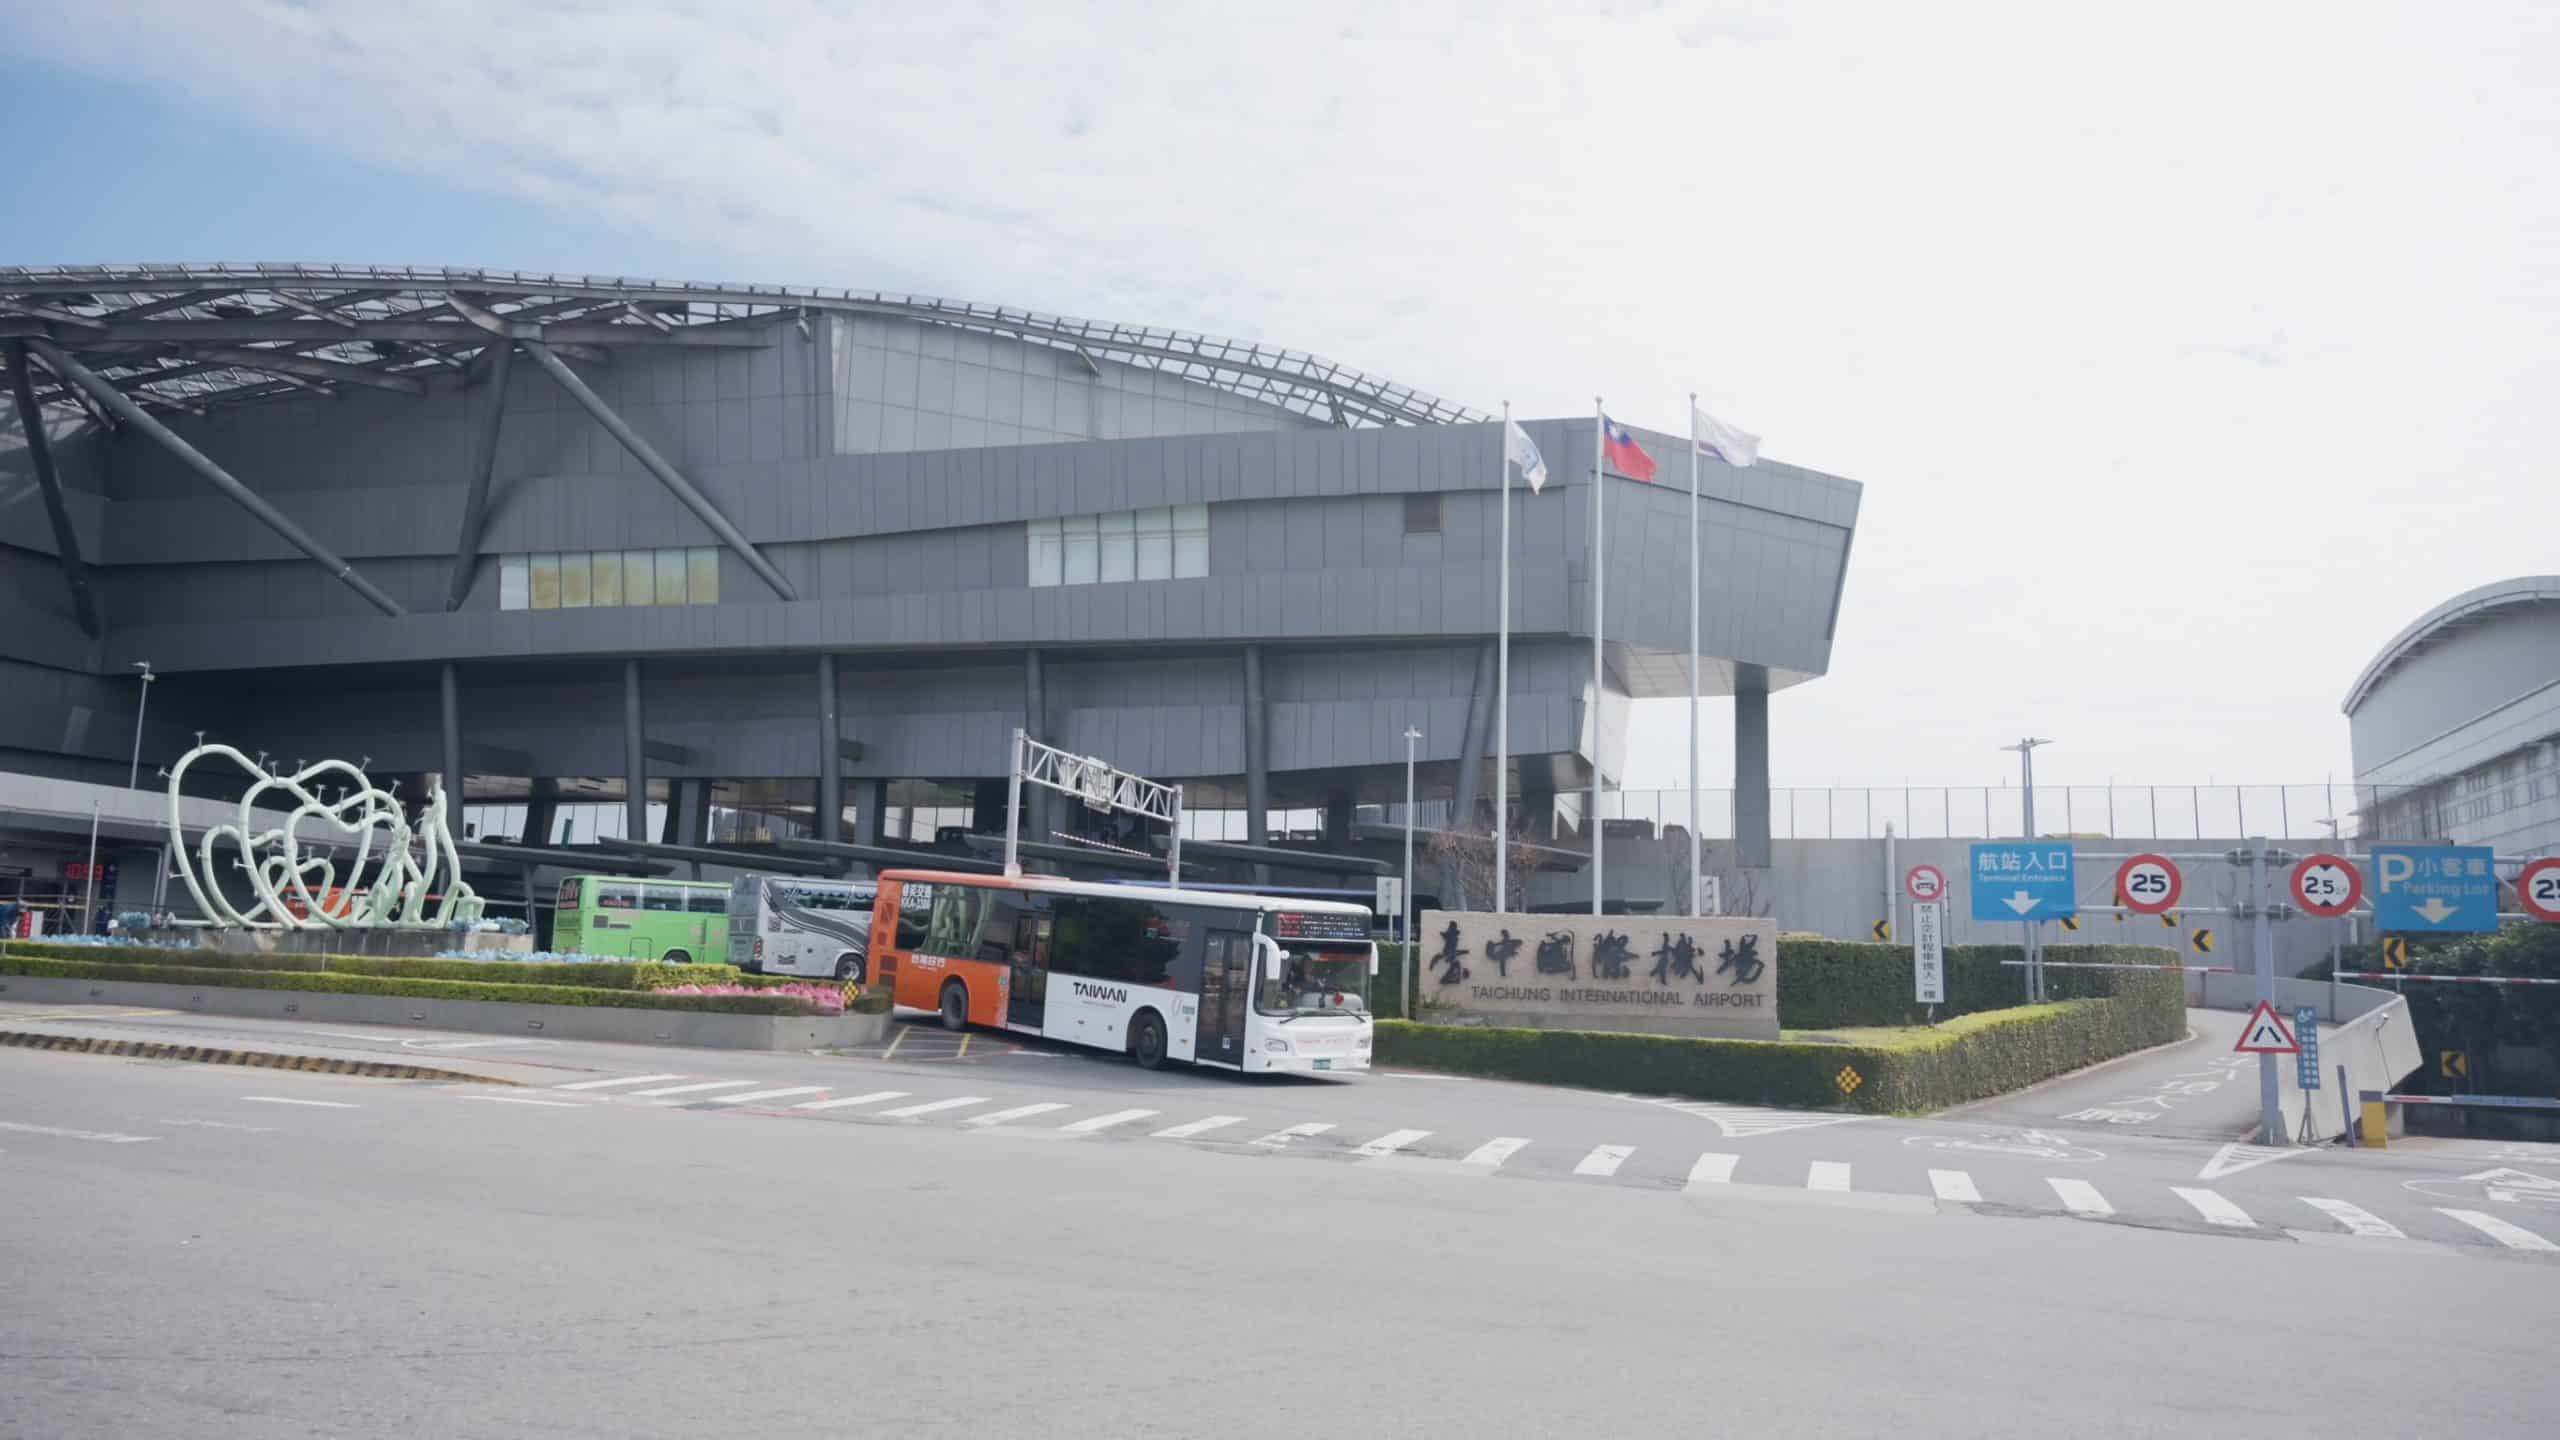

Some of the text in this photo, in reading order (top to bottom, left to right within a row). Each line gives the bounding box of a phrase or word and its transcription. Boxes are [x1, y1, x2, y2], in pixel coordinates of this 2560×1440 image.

[1978, 850, 2066, 871] 航站入口
[2416, 856, 2488, 877] 小客車
[2021, 873, 2065, 881] Entrance
[2131, 873, 2166, 893] 25
[2379, 853, 2414, 894] P
[2402, 881, 2490, 899] Parking Lot
[1073, 981, 1127, 1003] TAIWAN
[1471, 985, 1767, 1008] TAICHUNG INTERNATIONAL AIRPORT
